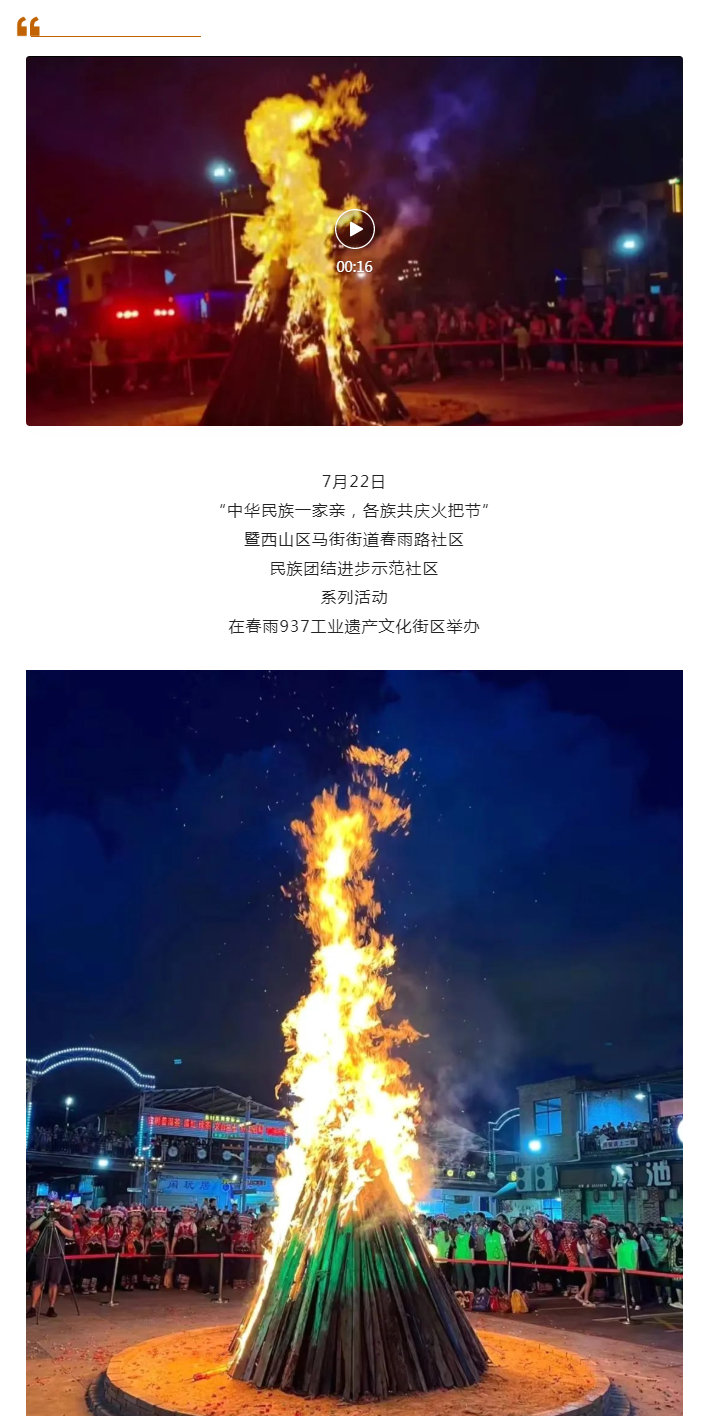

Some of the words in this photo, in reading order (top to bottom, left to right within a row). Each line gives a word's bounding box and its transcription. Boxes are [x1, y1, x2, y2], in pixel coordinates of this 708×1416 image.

[321, 474, 386, 490] 7月22日
[219, 502, 490, 519] “中华民族一家亲，各族共庆火把节”
[243, 530, 465, 548] 暨西山区马街街道春雨路社区
[270, 559, 439, 577] 民族团结进步示范社区
[320, 589, 389, 606] 系列活动
[228, 617, 481, 635] 在春雨937工业遗产文化街区举办
